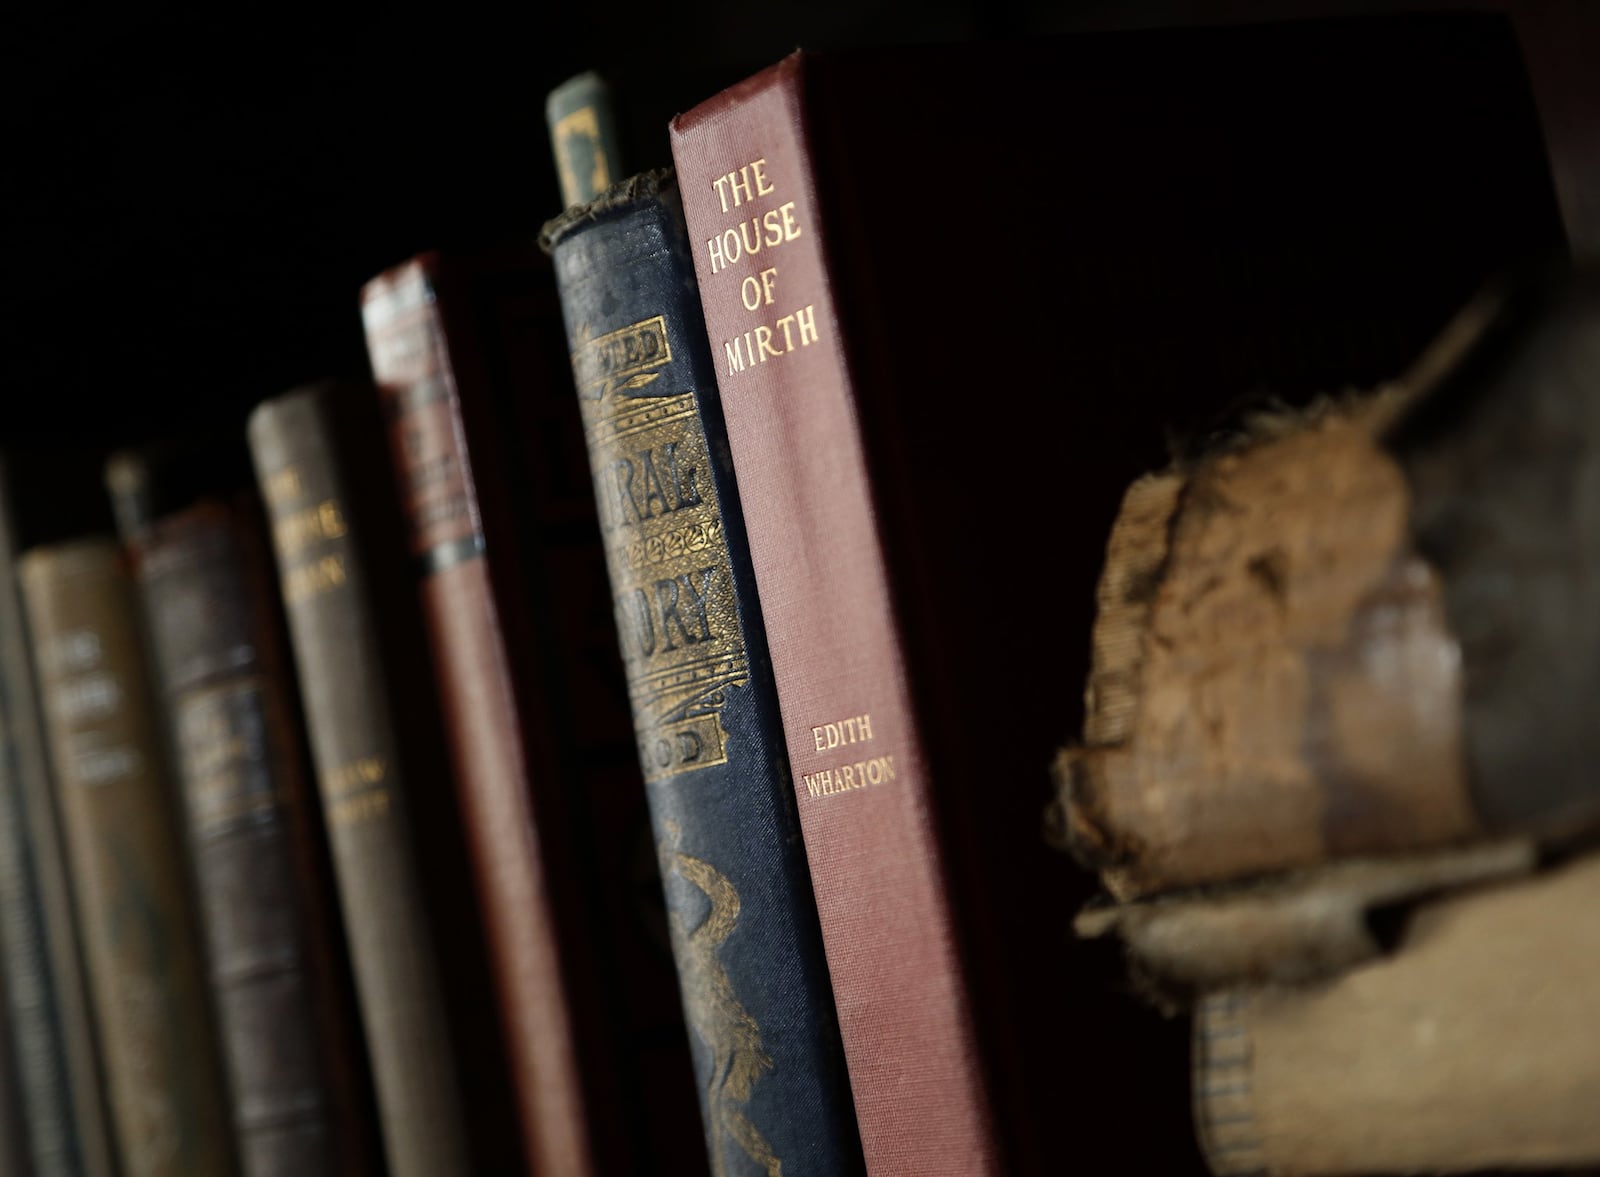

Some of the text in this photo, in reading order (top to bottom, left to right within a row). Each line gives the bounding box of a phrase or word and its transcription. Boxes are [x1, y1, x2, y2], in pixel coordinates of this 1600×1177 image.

[712, 158, 775, 213] THE
[706, 202, 802, 275] HOUSE
[741, 268, 778, 311] OF
[723, 305, 819, 377] MIRTH
[812, 714, 874, 752] EDITH
[802, 755, 896, 799] WHARTON
